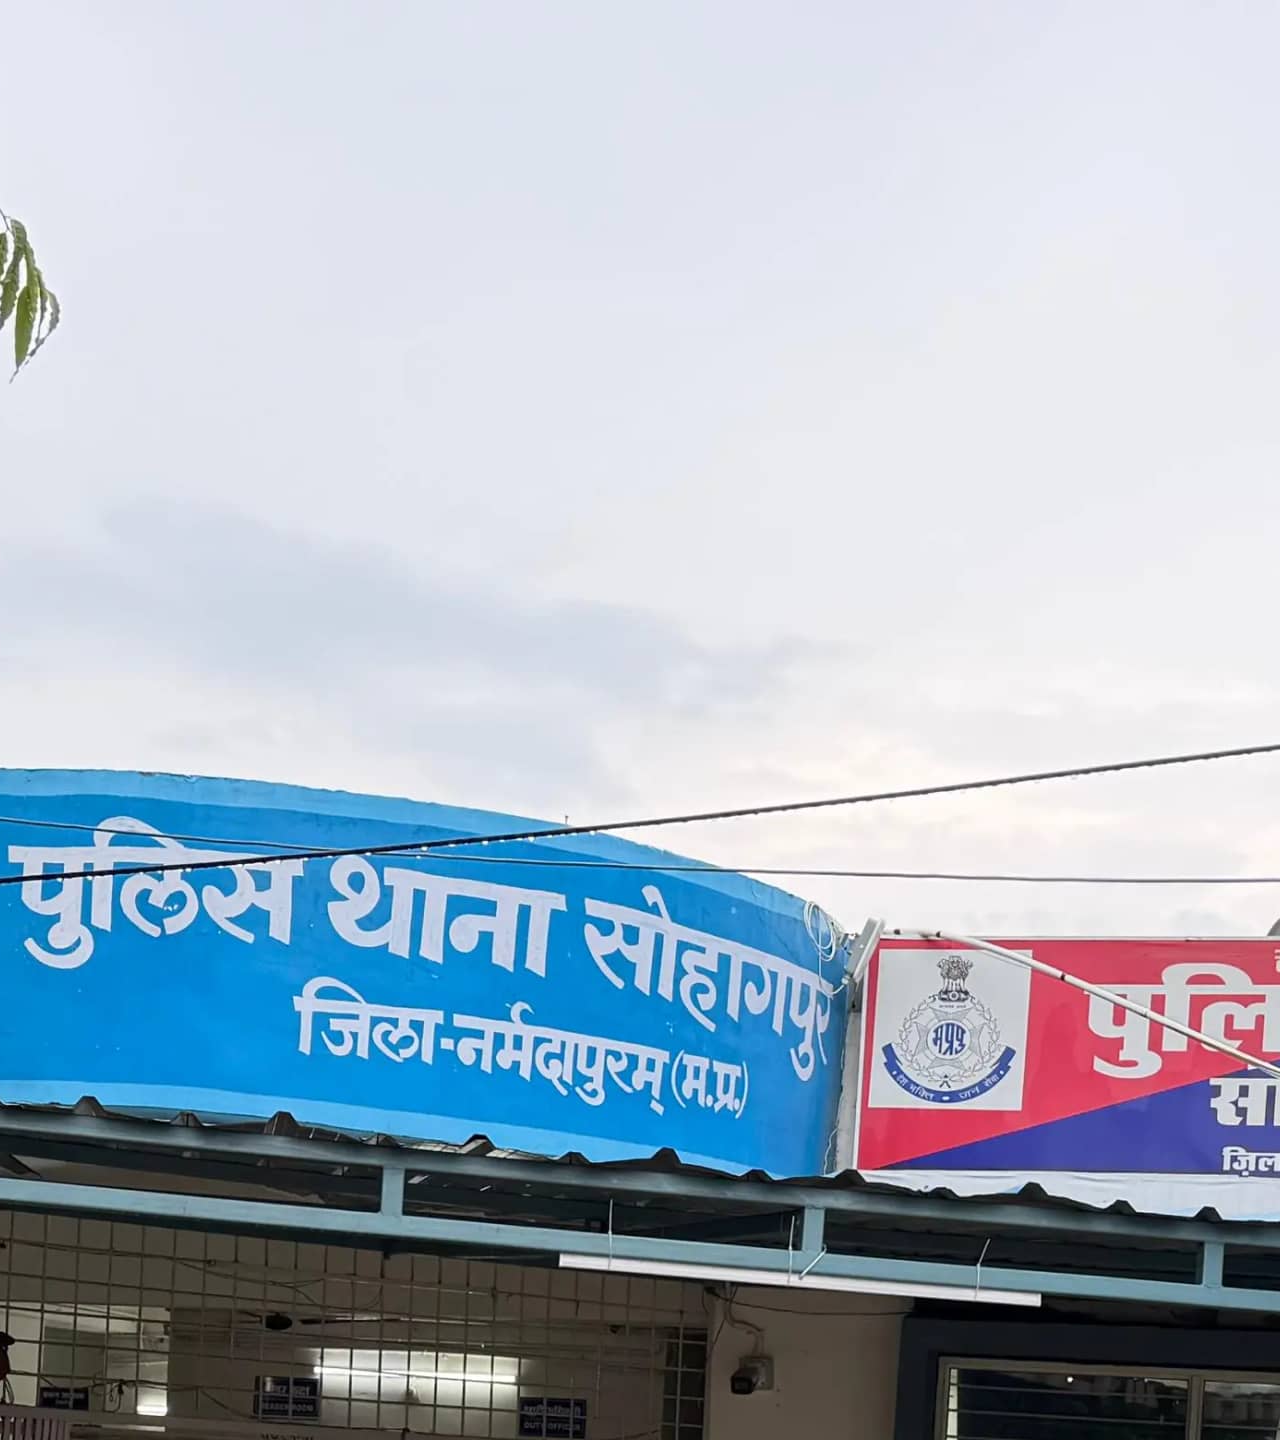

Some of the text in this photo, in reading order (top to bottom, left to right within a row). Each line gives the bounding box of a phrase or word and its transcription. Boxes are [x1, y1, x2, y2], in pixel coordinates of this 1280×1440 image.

[8, 815, 835, 1082] पुलिस थाना सोहागपुर
